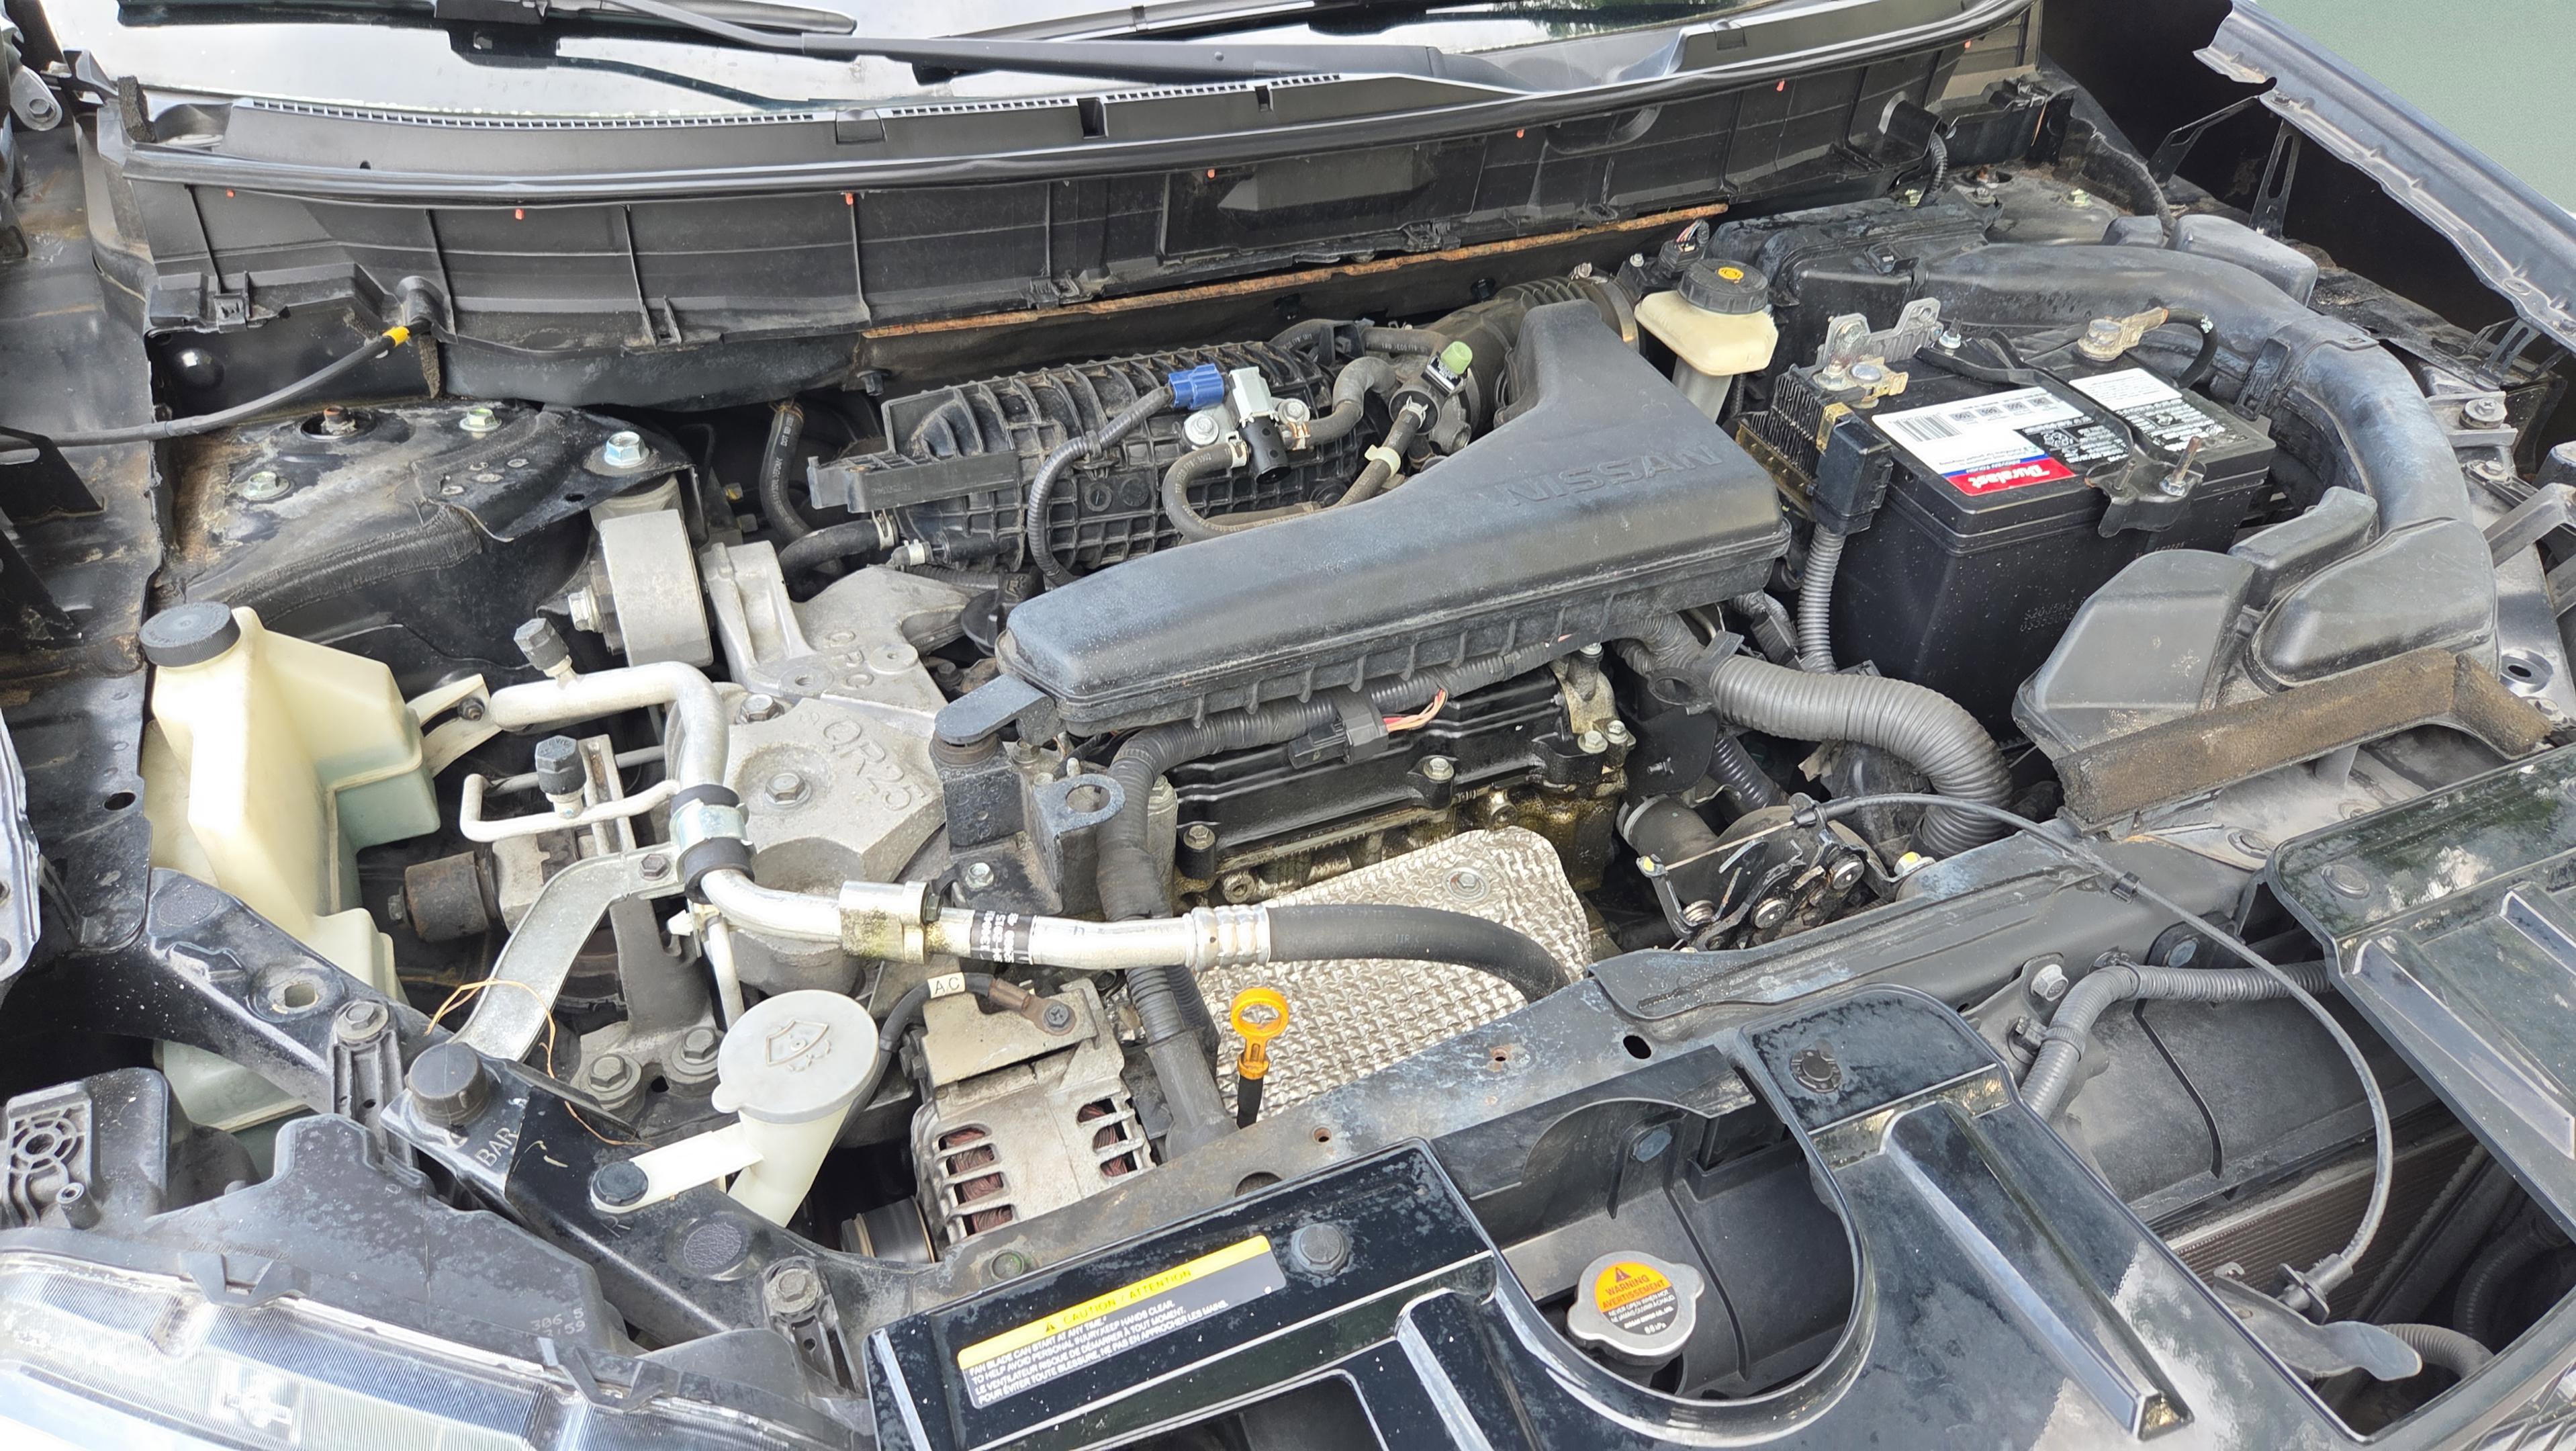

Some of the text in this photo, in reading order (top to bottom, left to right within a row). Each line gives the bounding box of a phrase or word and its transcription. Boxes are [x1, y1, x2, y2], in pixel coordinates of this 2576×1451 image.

[1495, 443, 1723, 507] NISSAN
[1968, 465, 2050, 489] Duralast
[823, 719, 927, 811] QR25
[935, 976, 960, 994] AC
[474, 1127, 518, 1168] BAR
[1062, 1299, 1116, 1325] CAUTION
[1128, 1269, 1192, 1299] ATTENTION
[1602, 1279, 1665, 1309] AVERTISSEMENT
[1605, 1274, 1650, 1296] WARNING
[968, 1363, 986, 1376] FAN
[986, 1353, 1013, 1370] BLADE
[1013, 1346, 1031, 1360] CAN
[1031, 1336, 1057, 1352] START
[1056, 1332, 1068, 1342] AT
[1067, 1325, 1085, 1338] ANY
[971, 1374, 985, 1385] TO
[984, 1365, 1007, 1380] HELP
[1006, 1356, 1032, 1372] AVOID
[1031, 1339, 1074, 1362] PERSONAL
[1120, 1310, 1148, 1327] HANDS
[1148, 1299, 1175, 1316] CLEAR.
[974, 1384, 987, 1395] LE
[986, 1364, 1039, 1391] VENTILATEUR
[1038, 1352, 1069, 1370] RISQUE
[1068, 1347, 1081, 1358] DE
[1080, 1329, 1123, 1354] DÉMARRER
[1130, 1320, 1151, 1334] TOUT
[1150, 1306, 1186, 1326] MOMENT.
[978, 1299, 1229, 1405] POUR ÉVITER TOUTE BLESSURE, NE PAS EN APPROCHER LES MAINS.
